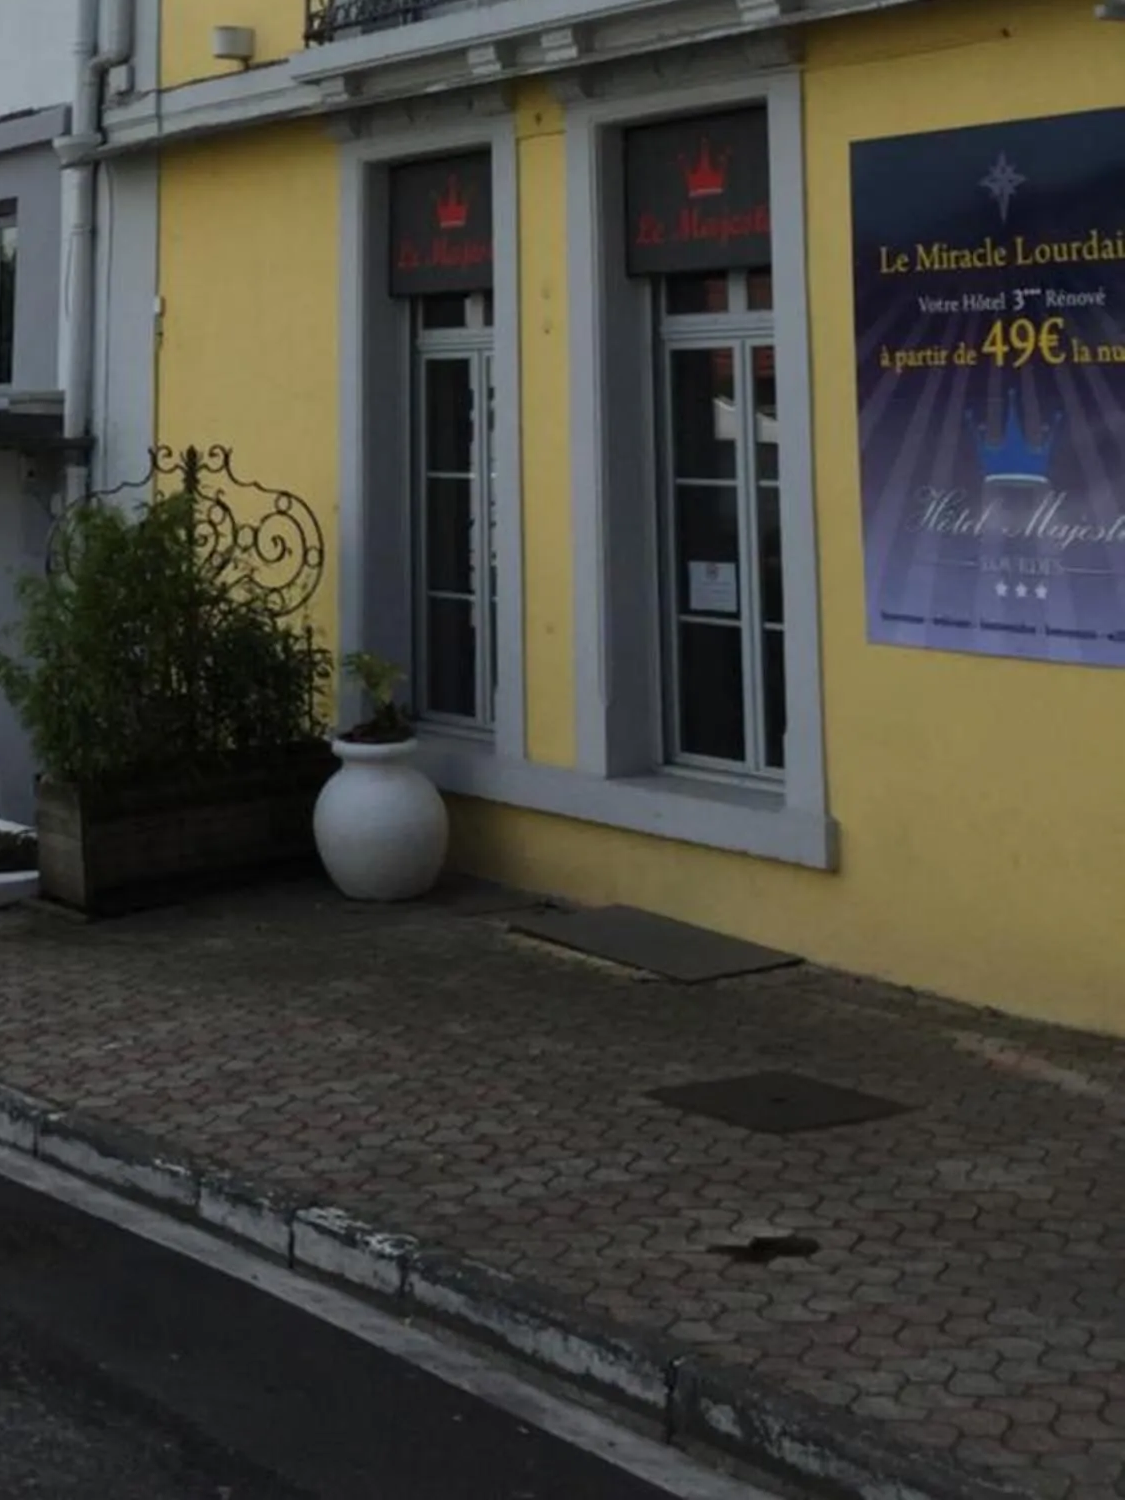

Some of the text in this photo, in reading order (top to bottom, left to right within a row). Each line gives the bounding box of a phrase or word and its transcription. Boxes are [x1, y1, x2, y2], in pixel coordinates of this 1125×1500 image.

[879, 246, 909, 274] Le
[915, 237, 1006, 272] Miracle
[918, 295, 959, 313] Votre
[1045, 286, 1106, 308] Rénové
[895, 344, 947, 373] partir
[953, 342, 977, 366] de
[981, 316, 1066, 368] 49€
[1072, 338, 1093, 363] la
